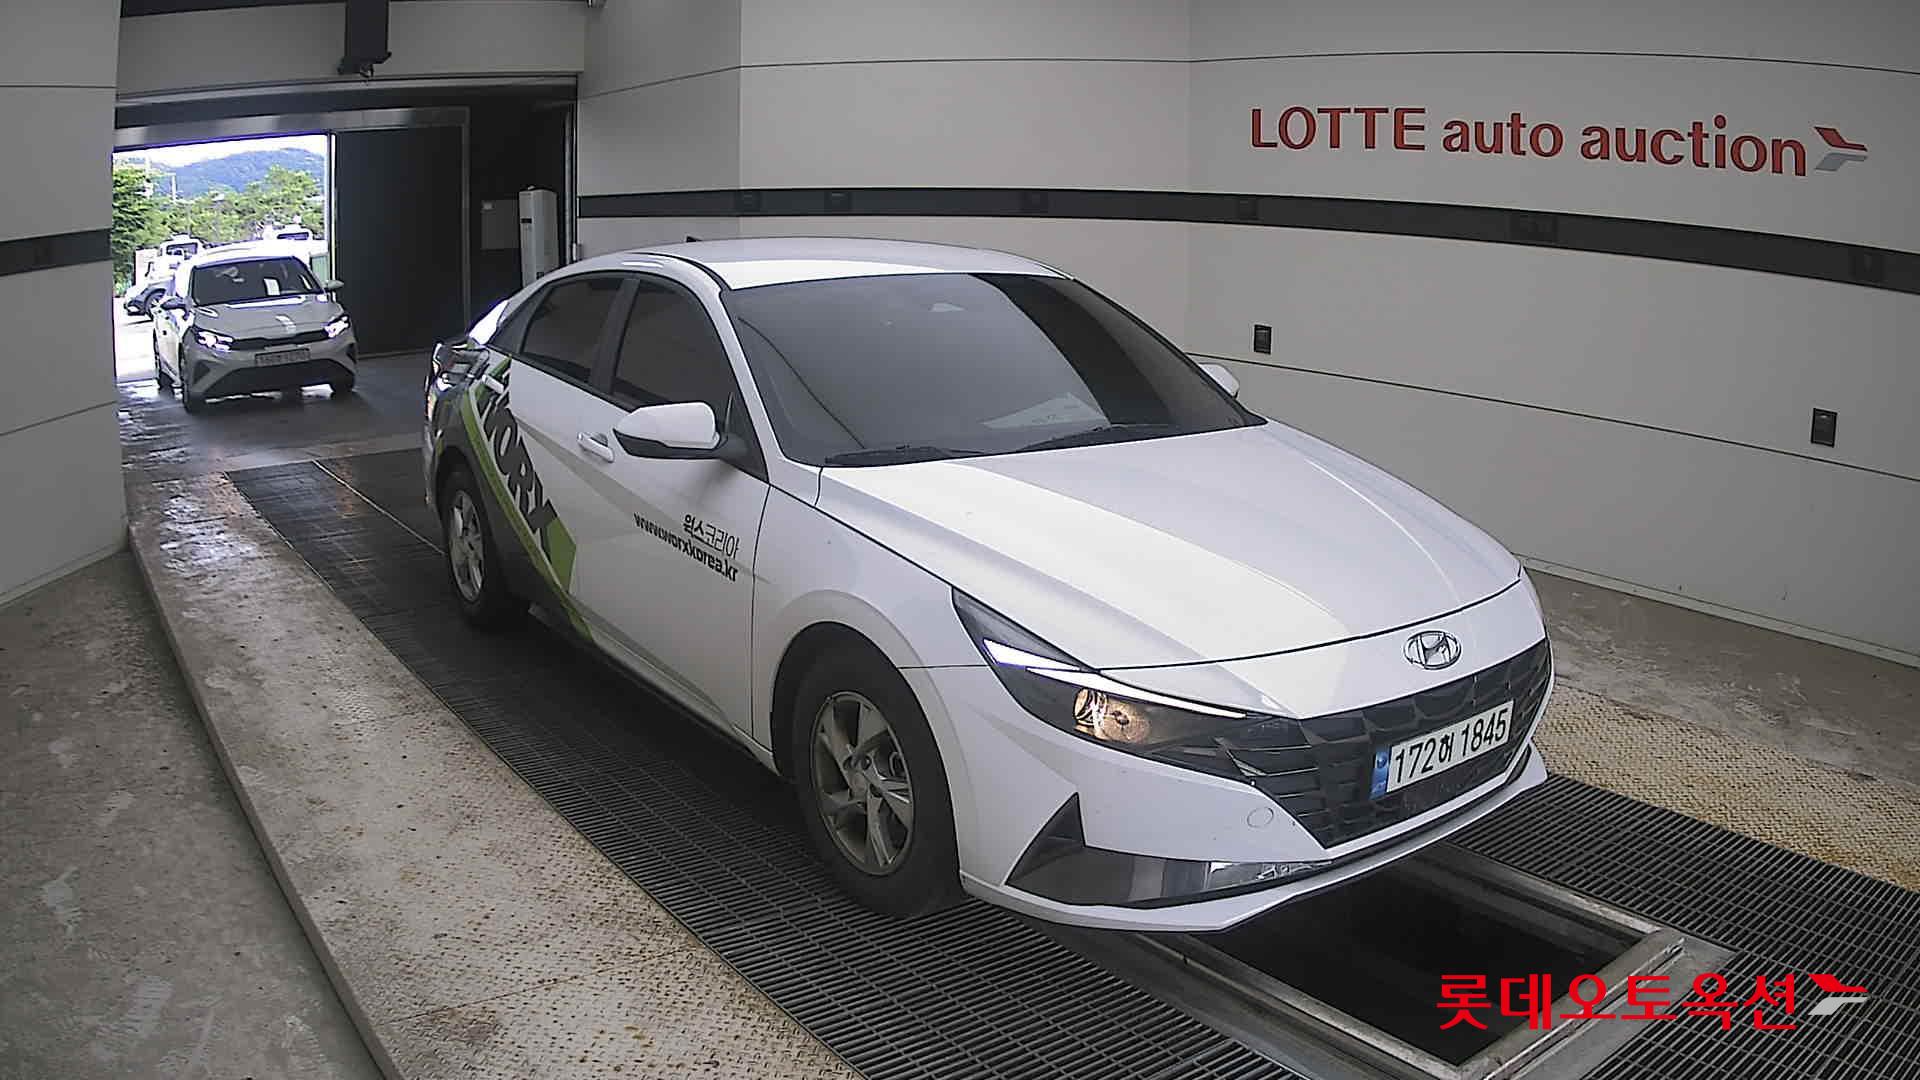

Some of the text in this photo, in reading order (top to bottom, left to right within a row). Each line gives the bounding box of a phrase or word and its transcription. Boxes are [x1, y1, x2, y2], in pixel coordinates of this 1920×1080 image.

[1251, 105, 1808, 178] LOTTE auto auction
[1460, 708, 1508, 757] 1845
